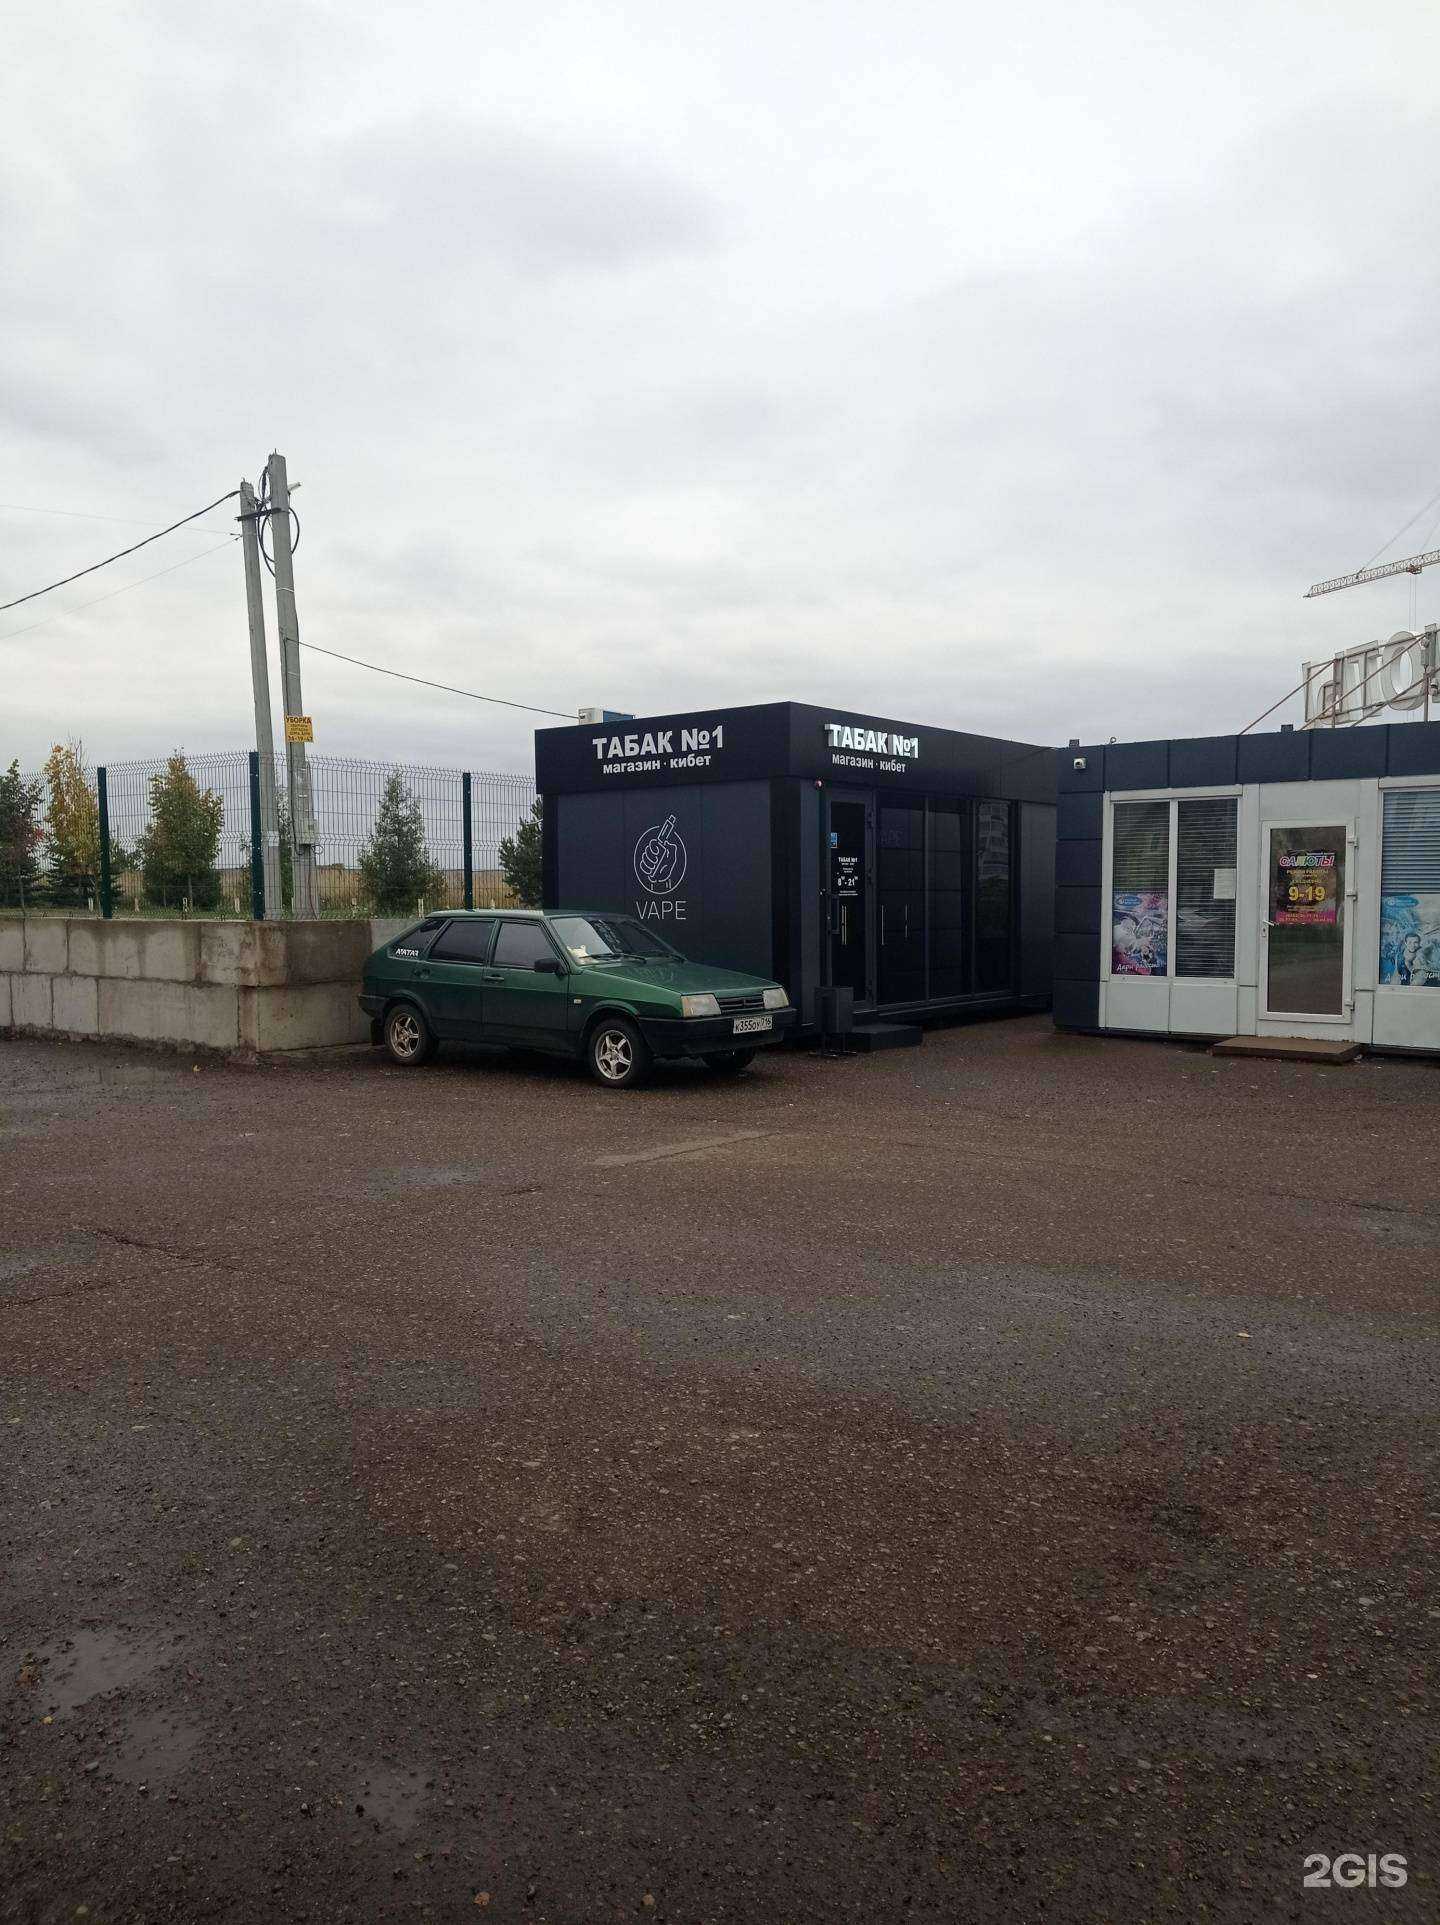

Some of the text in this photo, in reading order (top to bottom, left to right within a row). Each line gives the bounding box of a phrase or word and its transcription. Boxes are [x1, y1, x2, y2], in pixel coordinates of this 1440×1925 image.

[286, 716, 312, 724] УБОРКА
[592, 725, 724, 760] ТАБАК №1
[824, 723, 920, 760] ТАБАК №1
[603, 754, 712, 774] магазин кибет
[831, 754, 906, 774] магазин кибет
[1280, 855, 1335, 867] САЛЮТЫ
[1288, 886, 1326, 901] 9-19
[635, 901, 688, 921] VAPE
